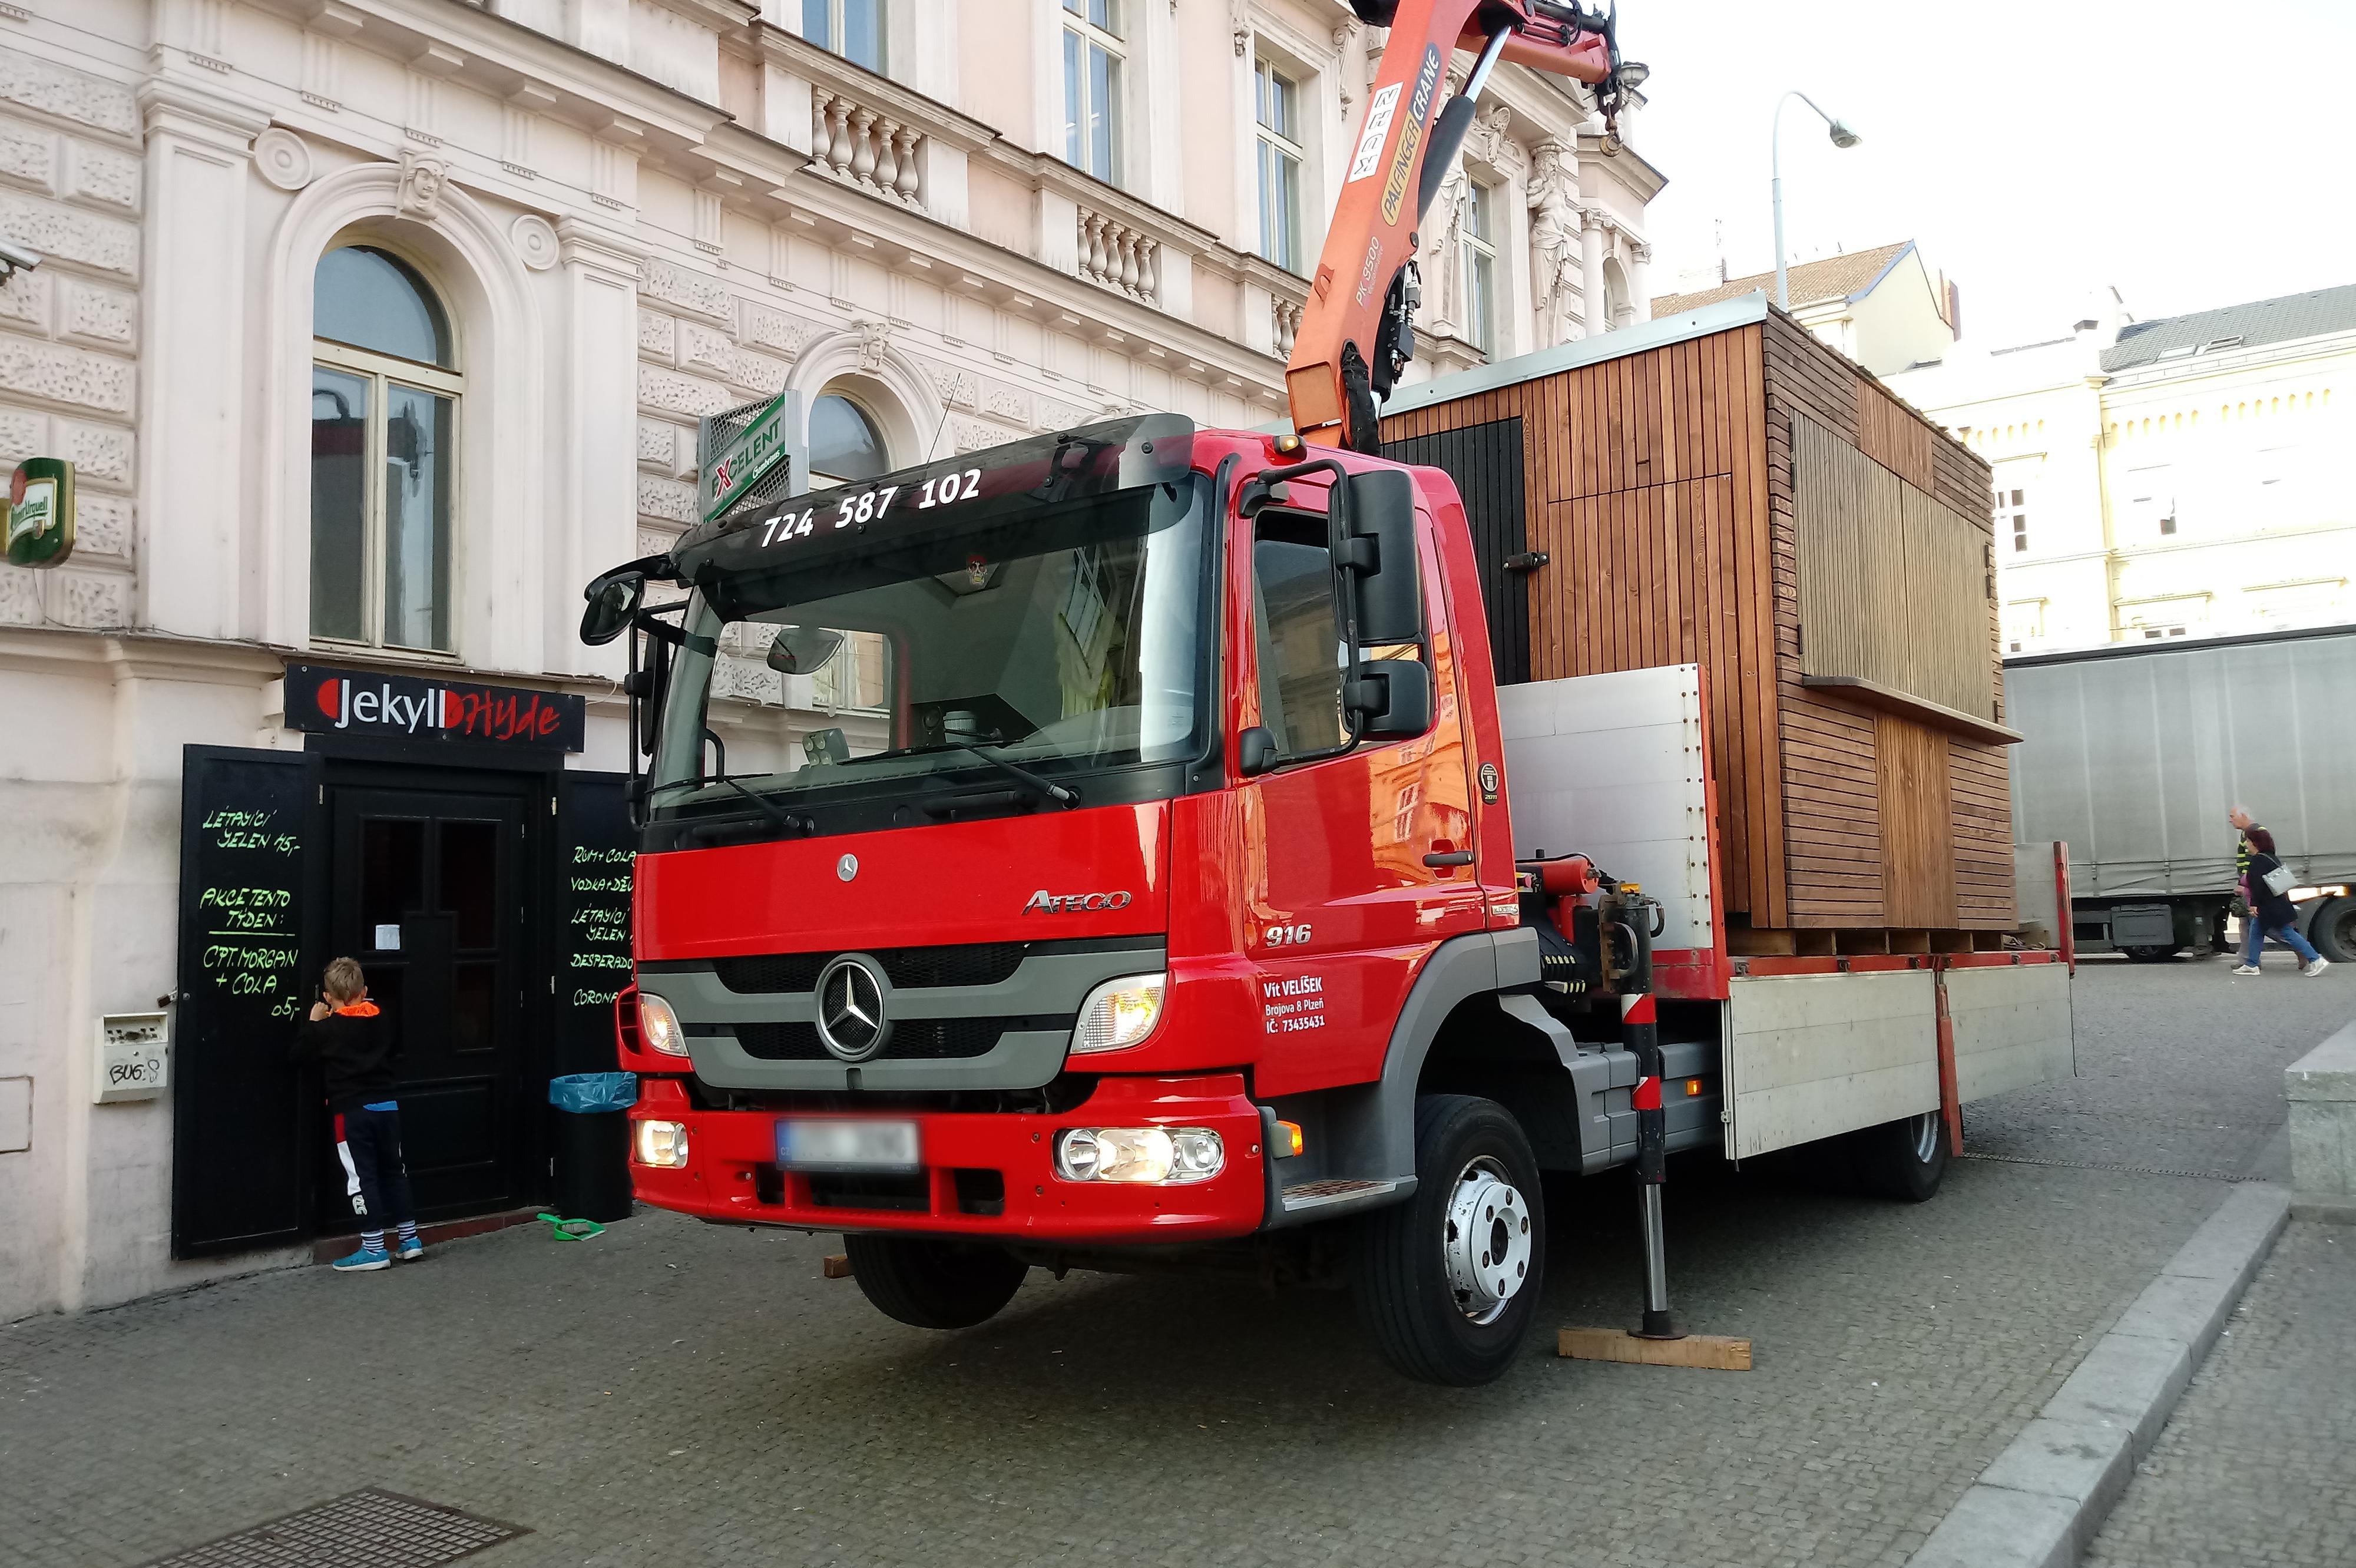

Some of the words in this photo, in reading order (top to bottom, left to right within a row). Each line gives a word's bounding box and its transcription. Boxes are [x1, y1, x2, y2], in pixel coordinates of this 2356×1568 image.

[1384, 118, 1419, 220] PALFINGER
[1412, 49, 1440, 122] CRANE
[1355, 281, 1367, 307] PK
[752, 449, 780, 479] Gambrinus
[25, 497, 48, 517] Urquell
[761, 507, 814, 548] 724
[834, 485, 900, 530] 587
[918, 469, 982, 511] 102
[335, 678, 446, 734] Jekyll
[461, 689, 560, 741] Hyde
[605, 848, 637, 864] COLA
[200, 888, 250, 909] AKCE
[249, 889, 290, 907] TENTO
[1266, 924, 1312, 947] 916
[237, 947, 299, 970] MORGAN
[570, 953, 634, 970] DESPERADO
[232, 972, 277, 994] COLA
[1263, 980, 1280, 998] Vít
[1281, 974, 1323, 997] VELÍŠEK
[1265, 1003, 1295, 1017] Brojova
[1296, 1000, 1302, 1013] 8
[1303, 997, 1324, 1011] Plzeň
[1266, 1018, 1279, 1034] IČ:
[1282, 1014, 1325, 1033] 73435431
[780, 1146, 790, 1156] CZ
